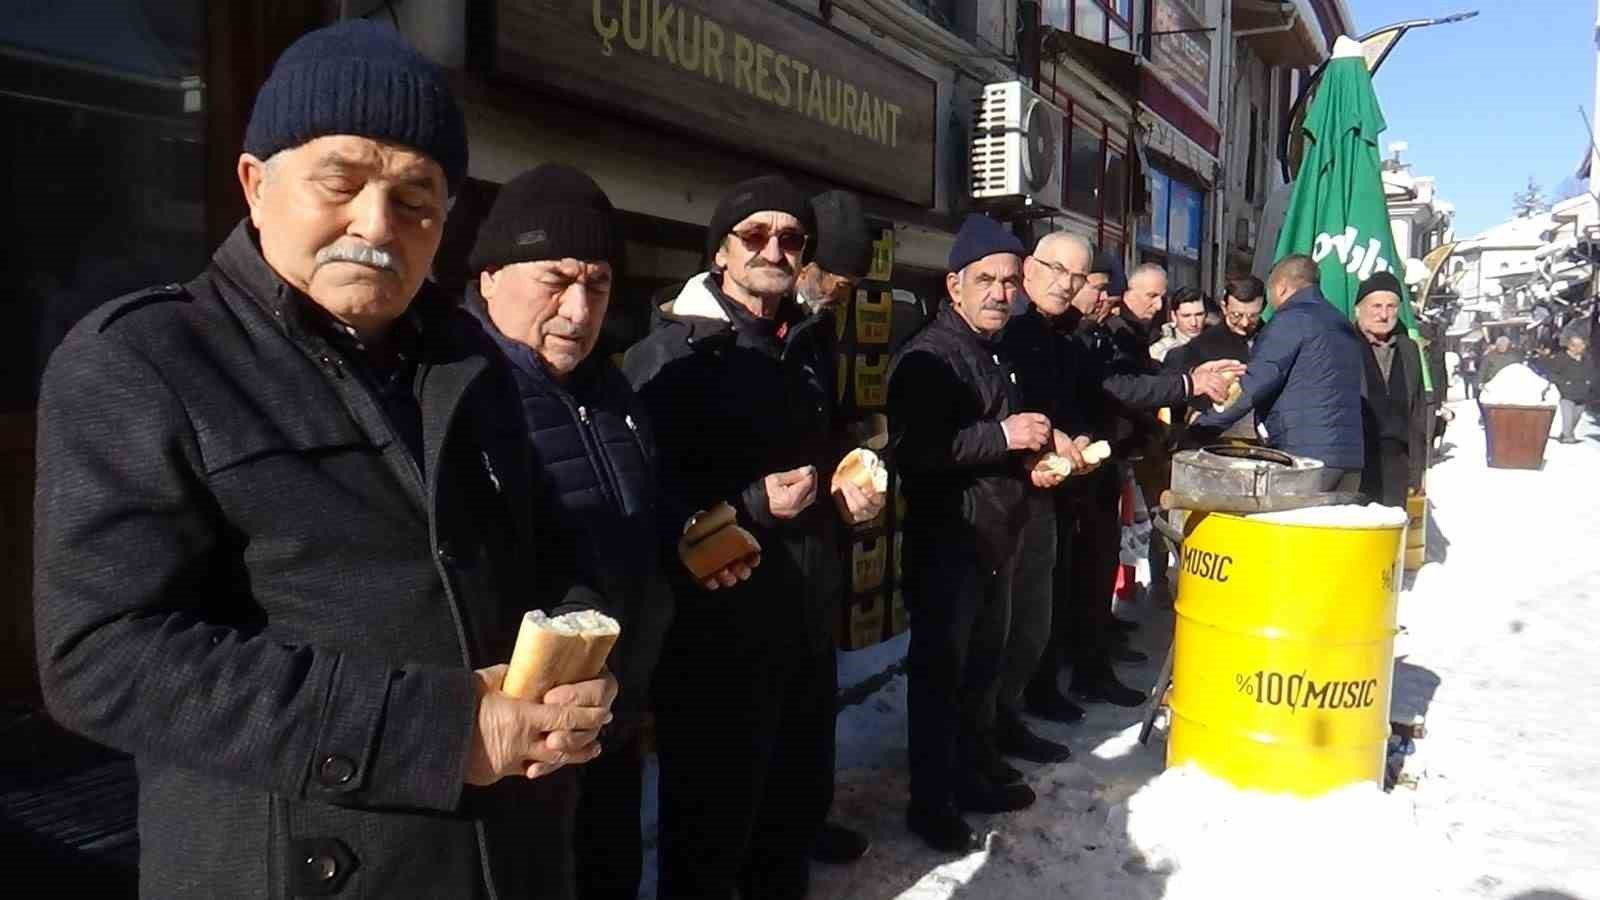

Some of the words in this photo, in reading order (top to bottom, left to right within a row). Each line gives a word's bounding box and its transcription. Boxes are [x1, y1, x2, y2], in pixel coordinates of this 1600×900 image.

[734, 34, 902, 147] RESTAURANT
[1182, 546, 1232, 583] MUSIC
[1302, 679, 1377, 709] MUSIC
